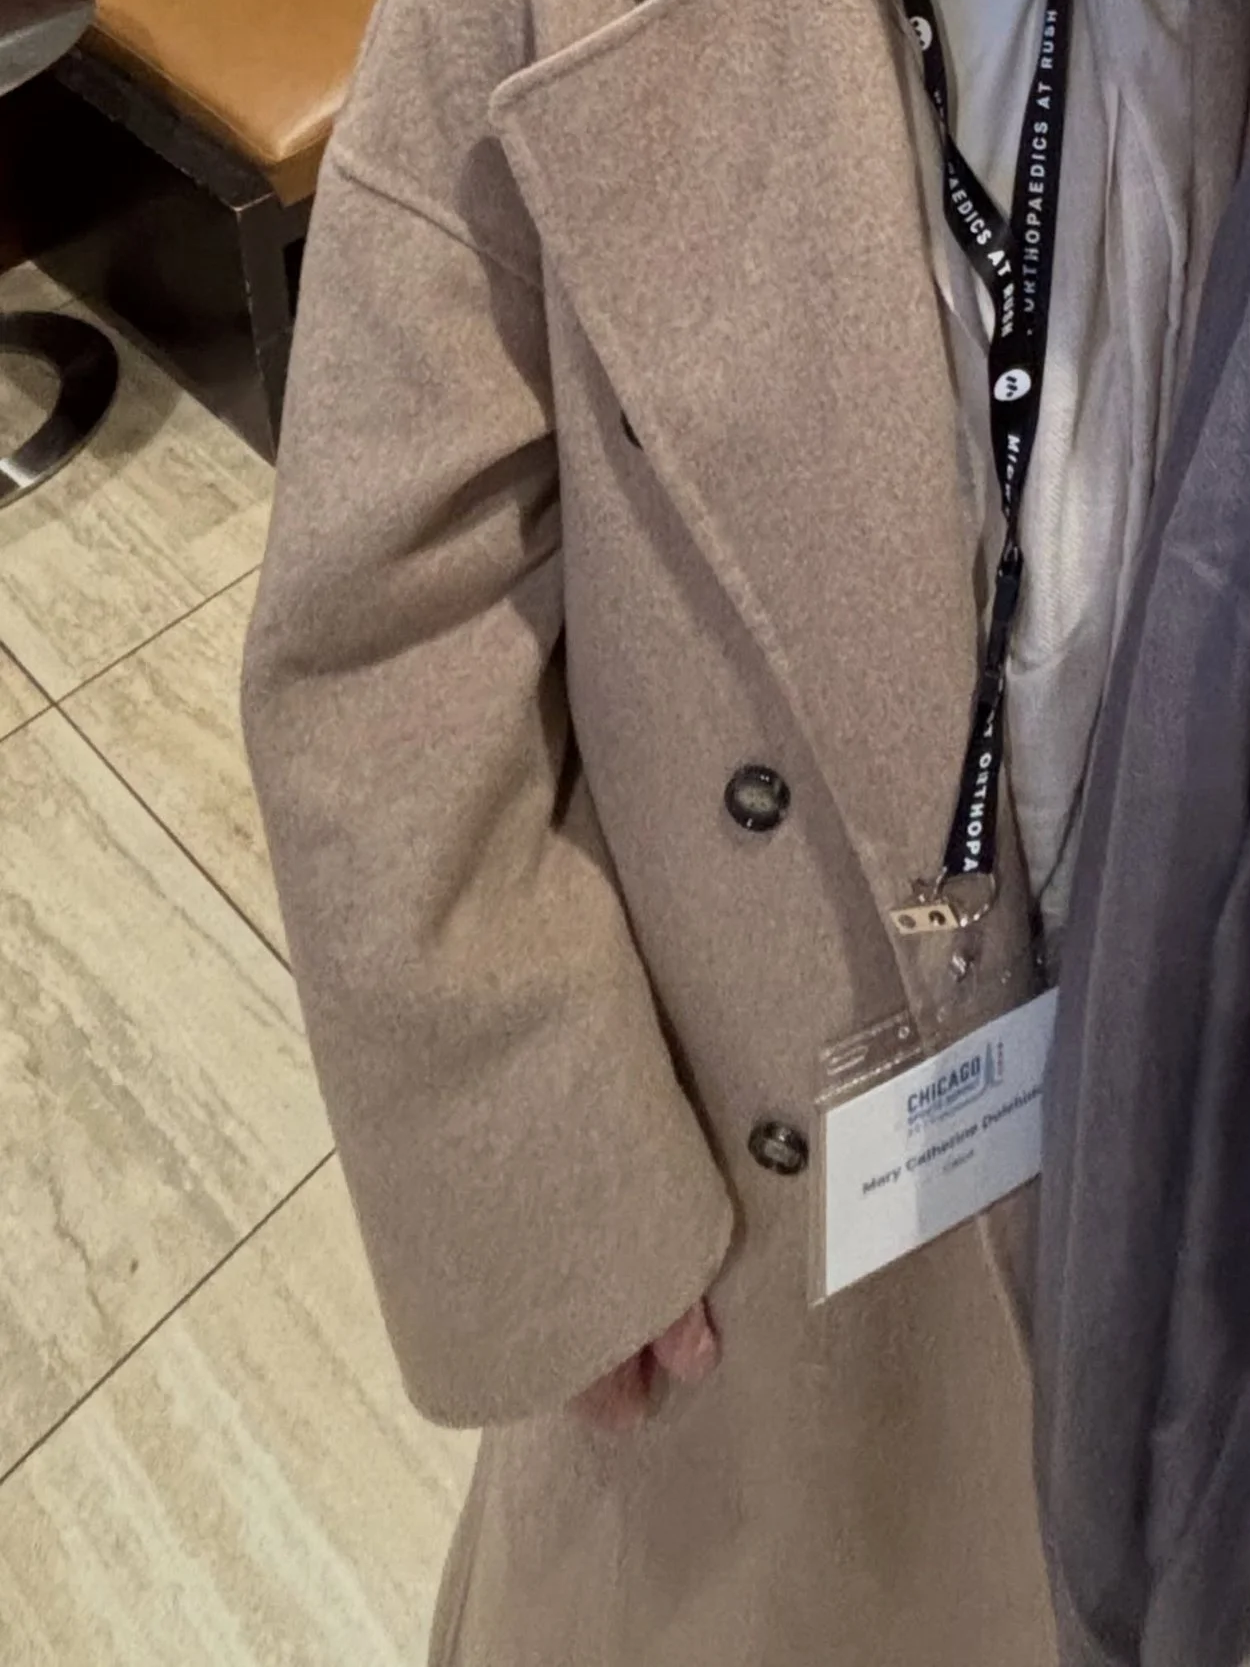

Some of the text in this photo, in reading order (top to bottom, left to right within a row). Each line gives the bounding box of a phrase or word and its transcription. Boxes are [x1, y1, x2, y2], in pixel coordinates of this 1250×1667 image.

[1040, 9, 1059, 70] RUSH
[1035, 81, 1053, 110] AT
[987, 249, 1012, 276] AT
[907, 1055, 982, 1113] CHICAGO
[862, 1166, 902, 1195] Mary
